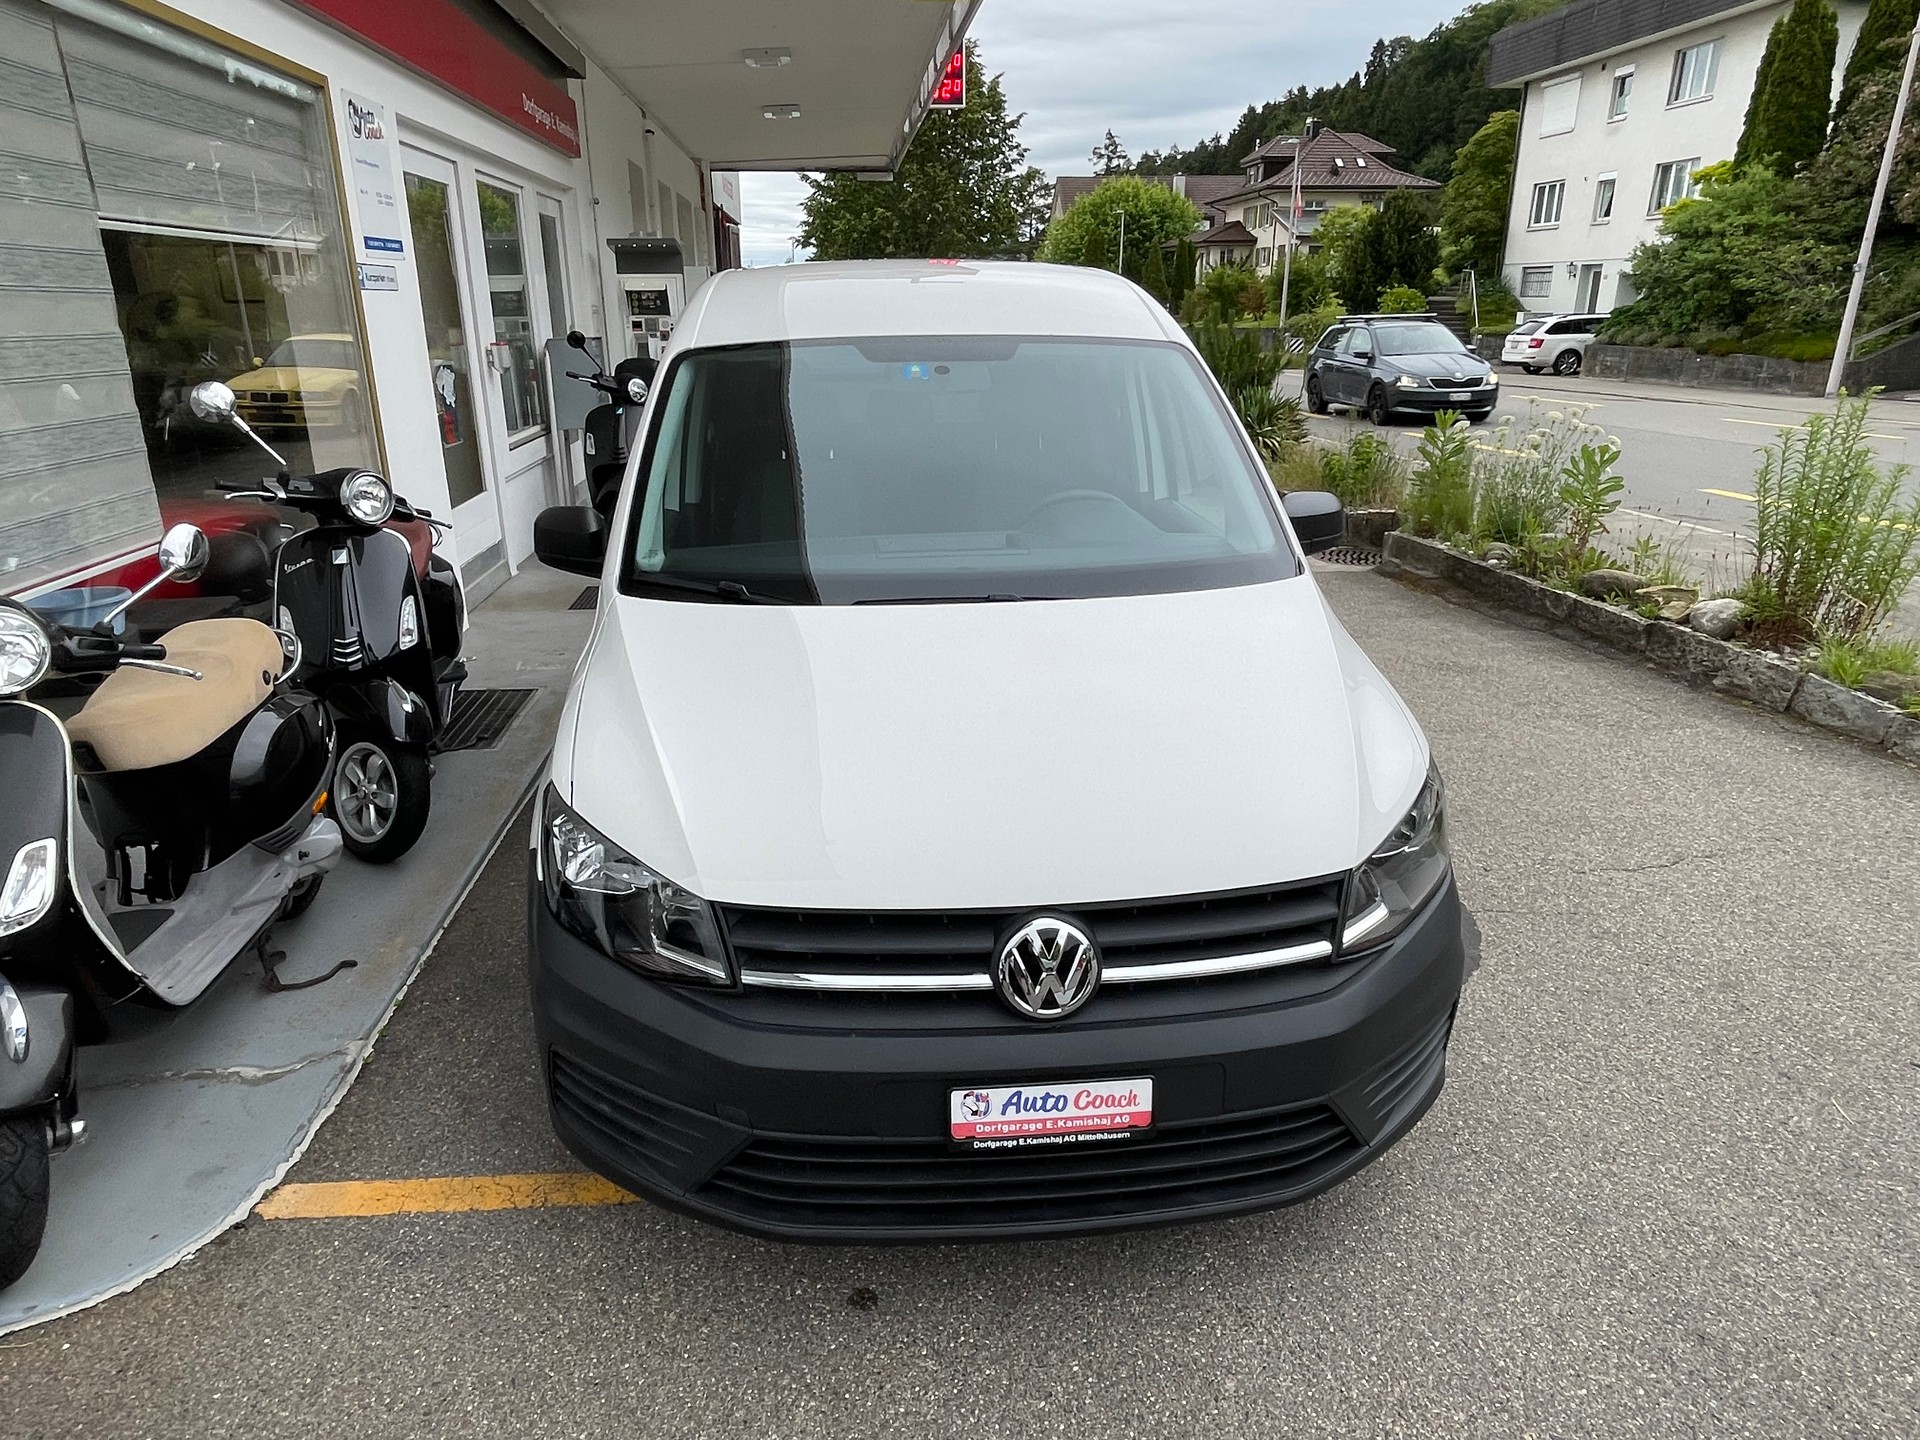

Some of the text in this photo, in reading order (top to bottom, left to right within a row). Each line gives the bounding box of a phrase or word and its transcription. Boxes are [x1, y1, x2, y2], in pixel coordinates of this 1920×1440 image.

[1000, 1089, 1140, 1116] Auto Coach
[975, 1114, 1130, 1134] Dorfgarage E.Kamishaj AG
[973, 1131, 1131, 1149] Dorfgarage E.Kamishaj AG Mittelhäusern
